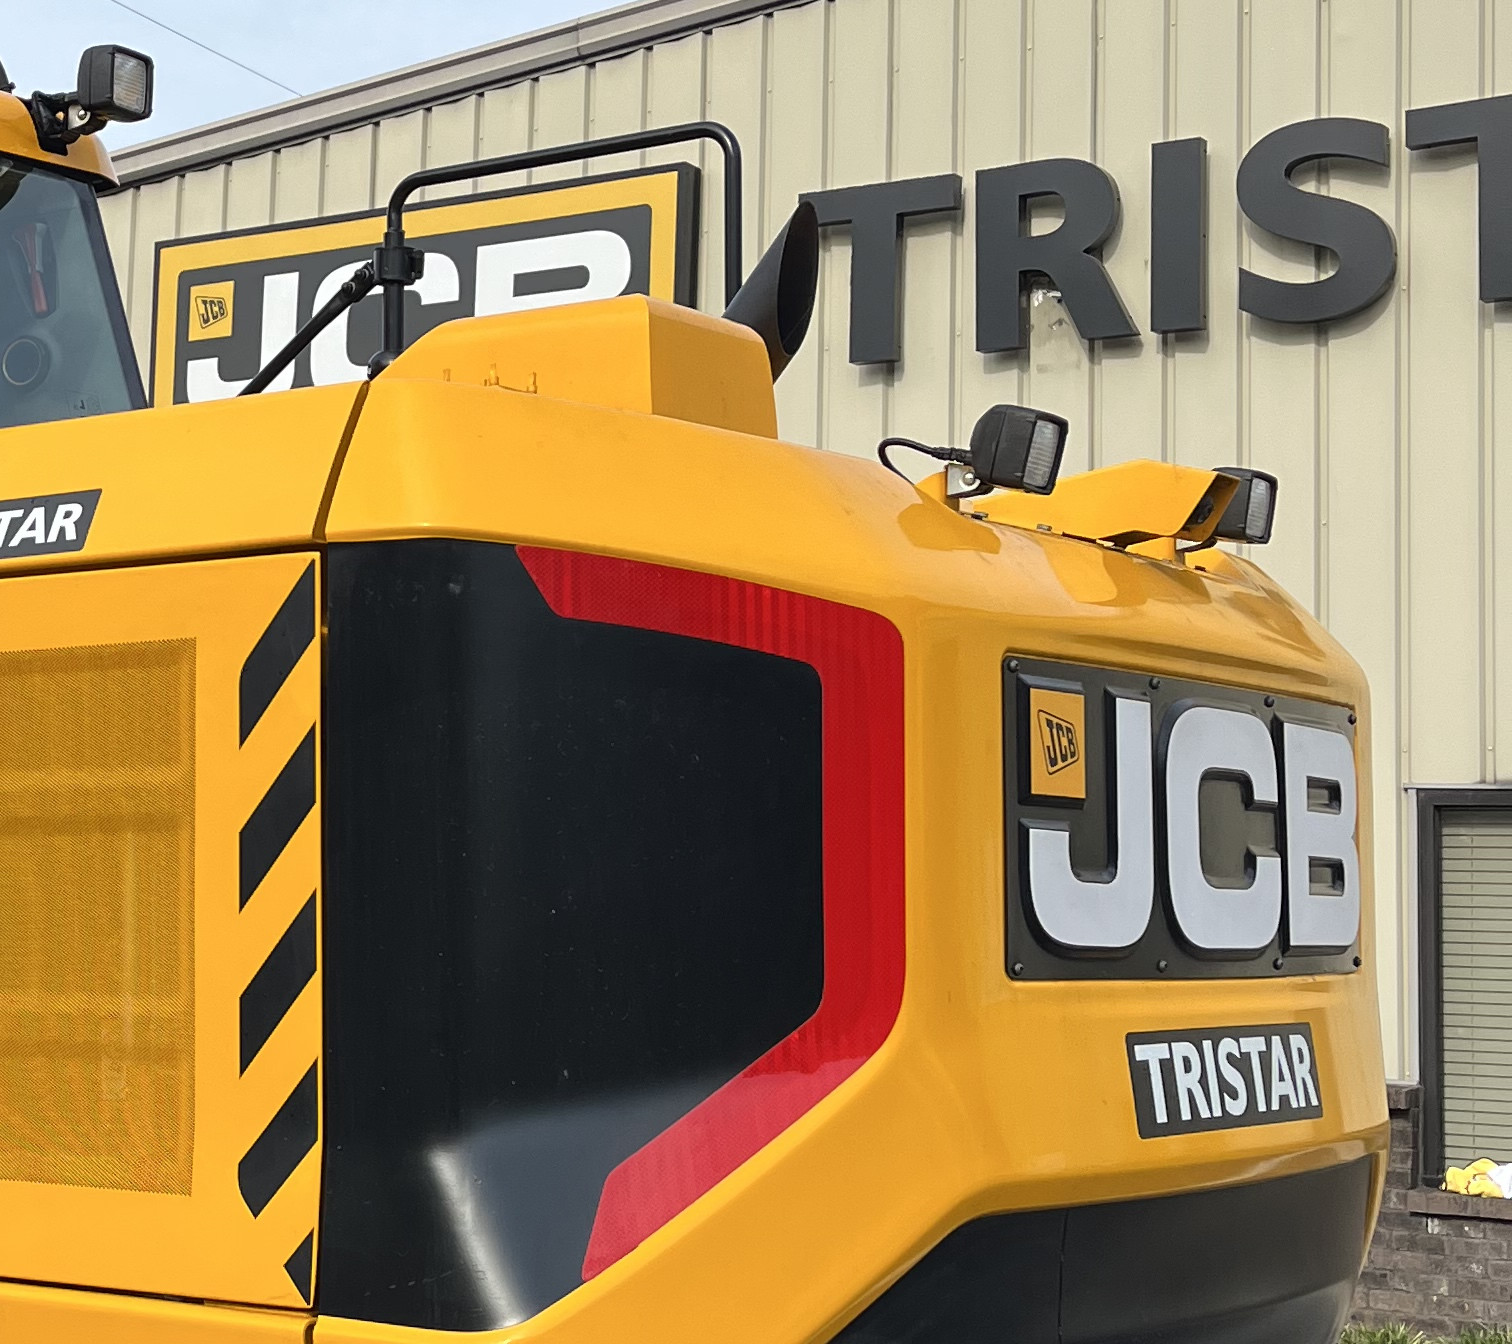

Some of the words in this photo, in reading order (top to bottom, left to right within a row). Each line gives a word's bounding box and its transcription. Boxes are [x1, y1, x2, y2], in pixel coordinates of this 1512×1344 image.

[200, 299, 226, 325] JCB
[1045, 717, 1076, 768] JCB
[1029, 697, 1361, 948] JCB
[1134, 1034, 1319, 1124] TRISTAR
